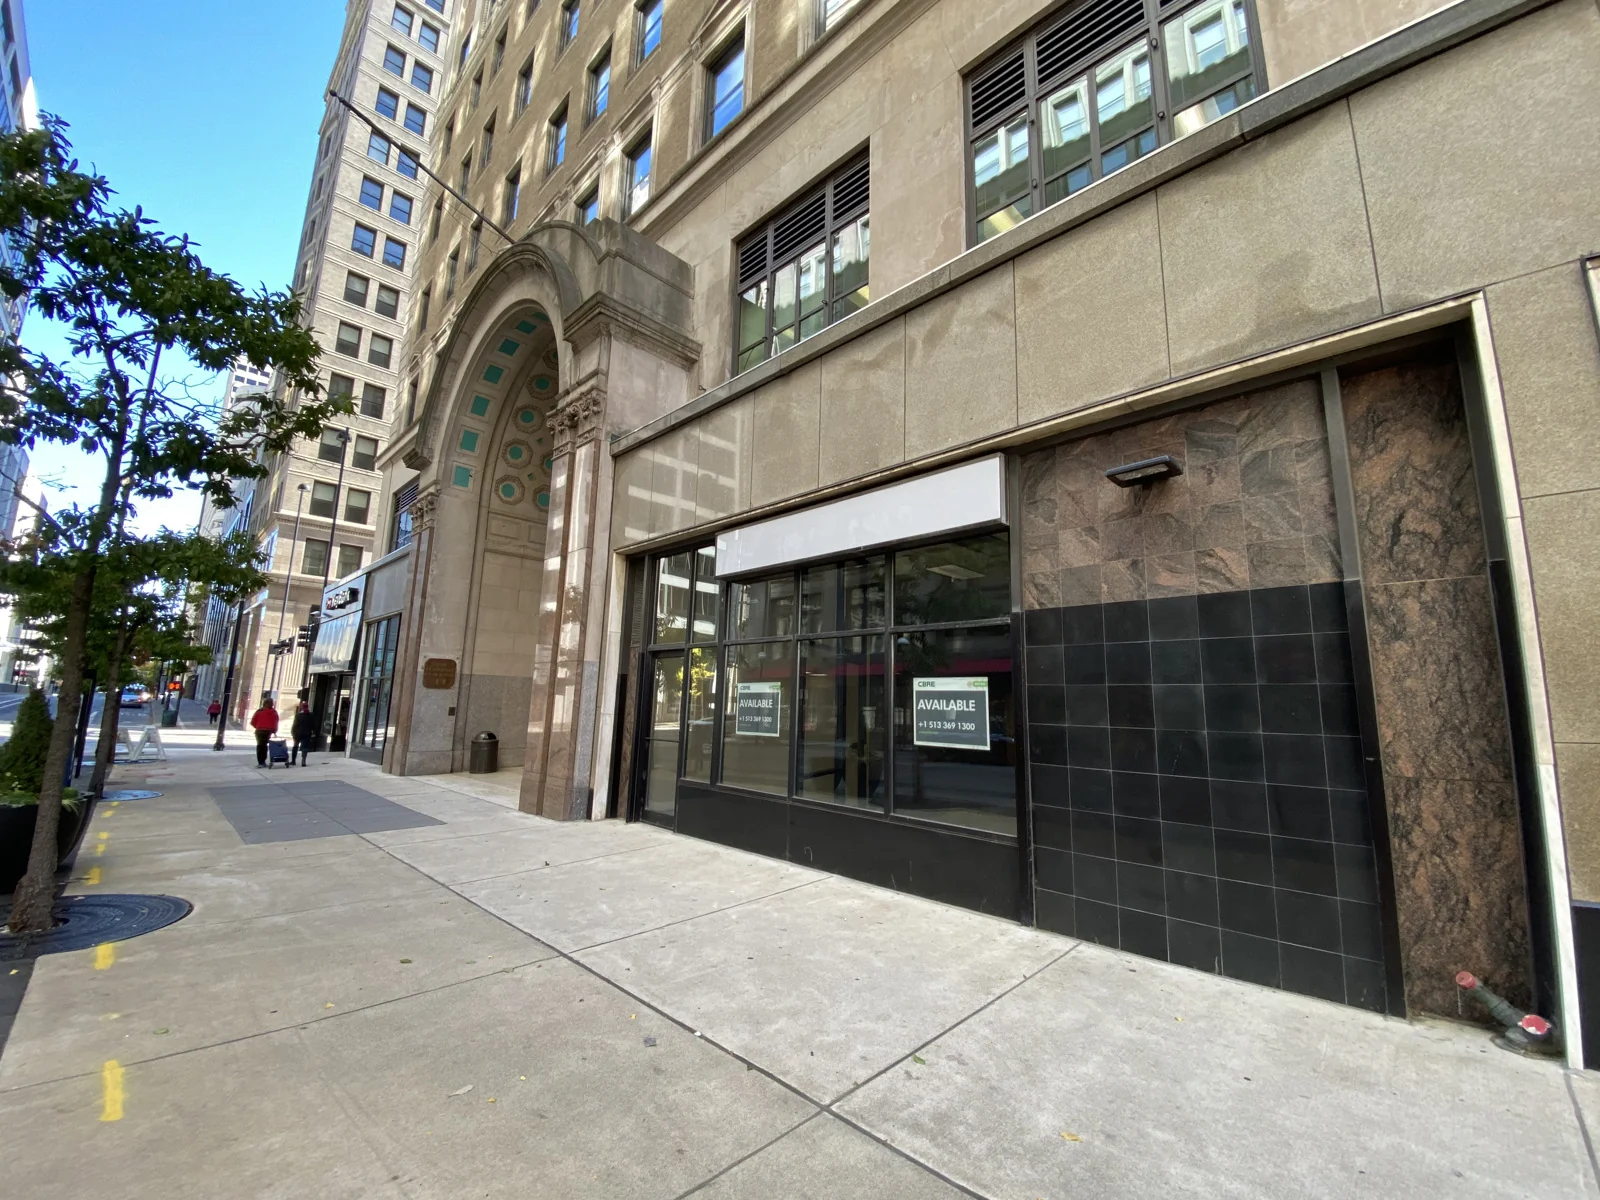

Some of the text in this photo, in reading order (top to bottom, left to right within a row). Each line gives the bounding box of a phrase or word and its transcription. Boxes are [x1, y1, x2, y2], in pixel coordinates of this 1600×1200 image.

[739, 699, 773, 708] AVAILABLE
[917, 699, 976, 711] AVAILABLE
[929, 721, 941, 729] 513
[943, 721, 956, 730] 369
[958, 722, 976, 731] 1300
